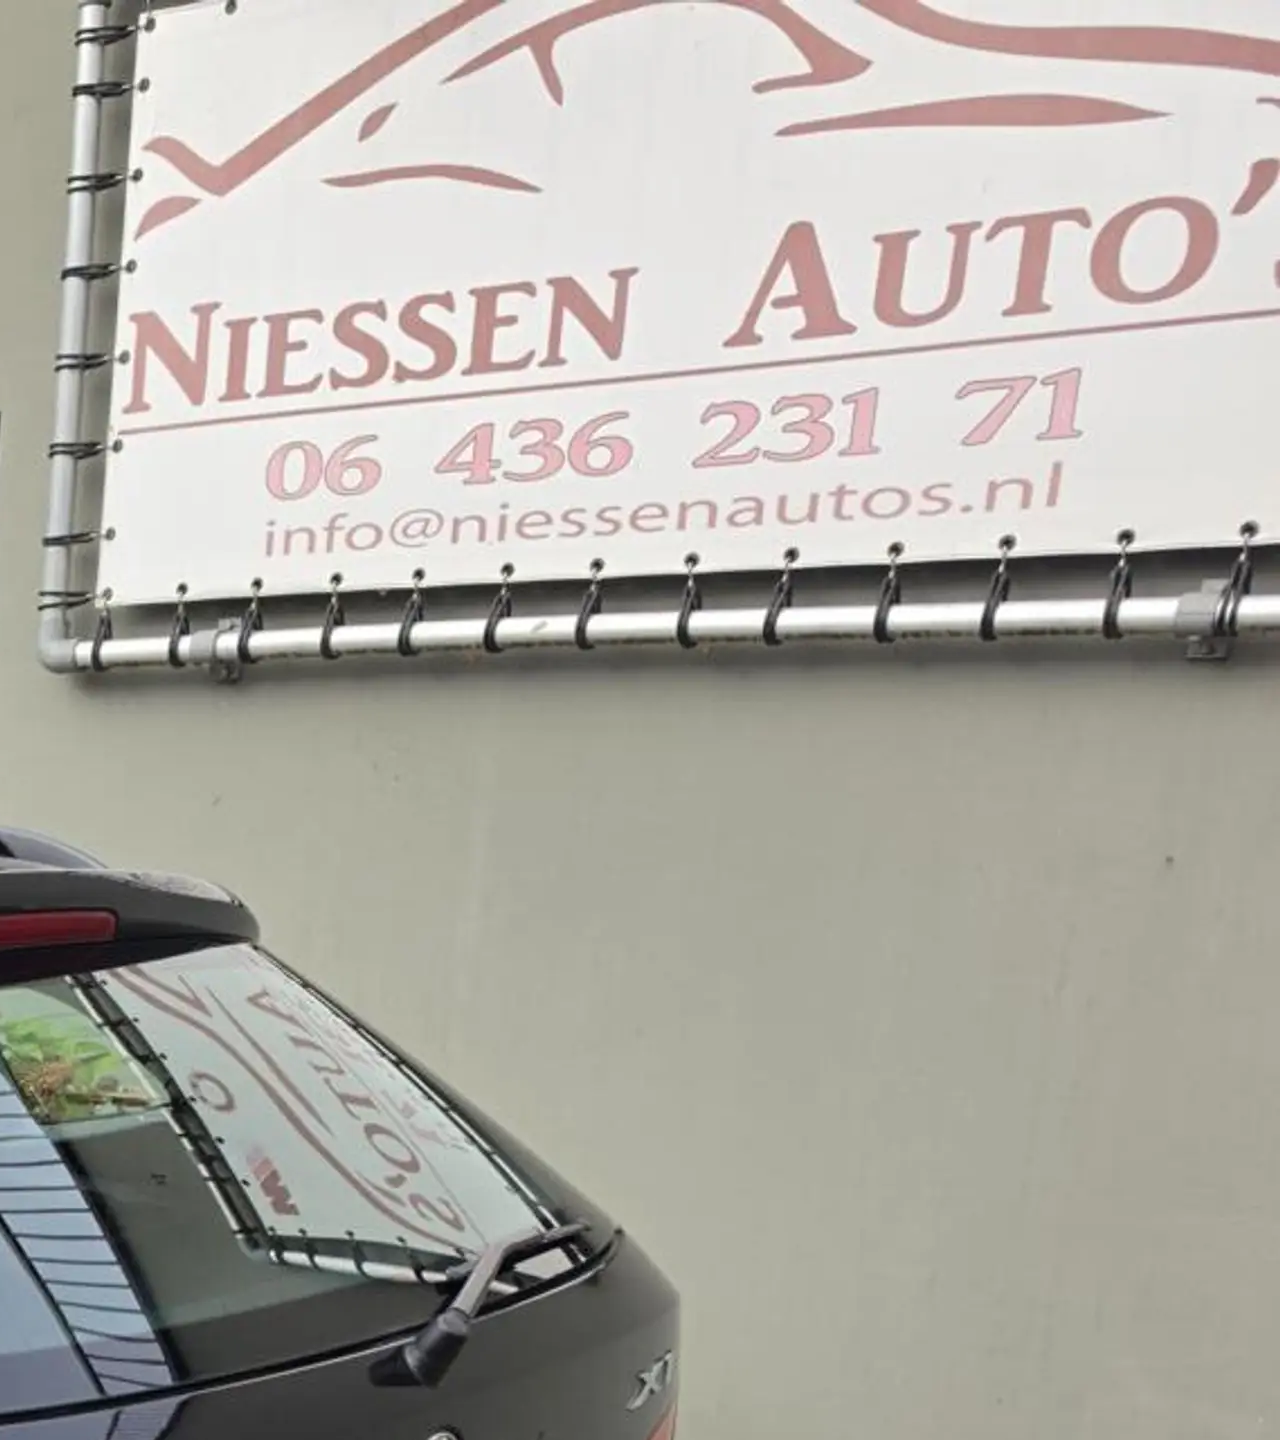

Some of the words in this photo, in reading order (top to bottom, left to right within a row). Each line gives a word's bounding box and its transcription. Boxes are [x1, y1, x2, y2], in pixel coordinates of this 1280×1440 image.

[123, 266, 641, 416] NIESSEN
[724, 155, 1280, 350] AUTO'
[265, 436, 382, 502] 06
[435, 411, 635, 488] 436
[691, 387, 880, 471] 231
[954, 367, 1085, 449] 71
[264, 462, 1064, 559] info@niessenautos.nl
